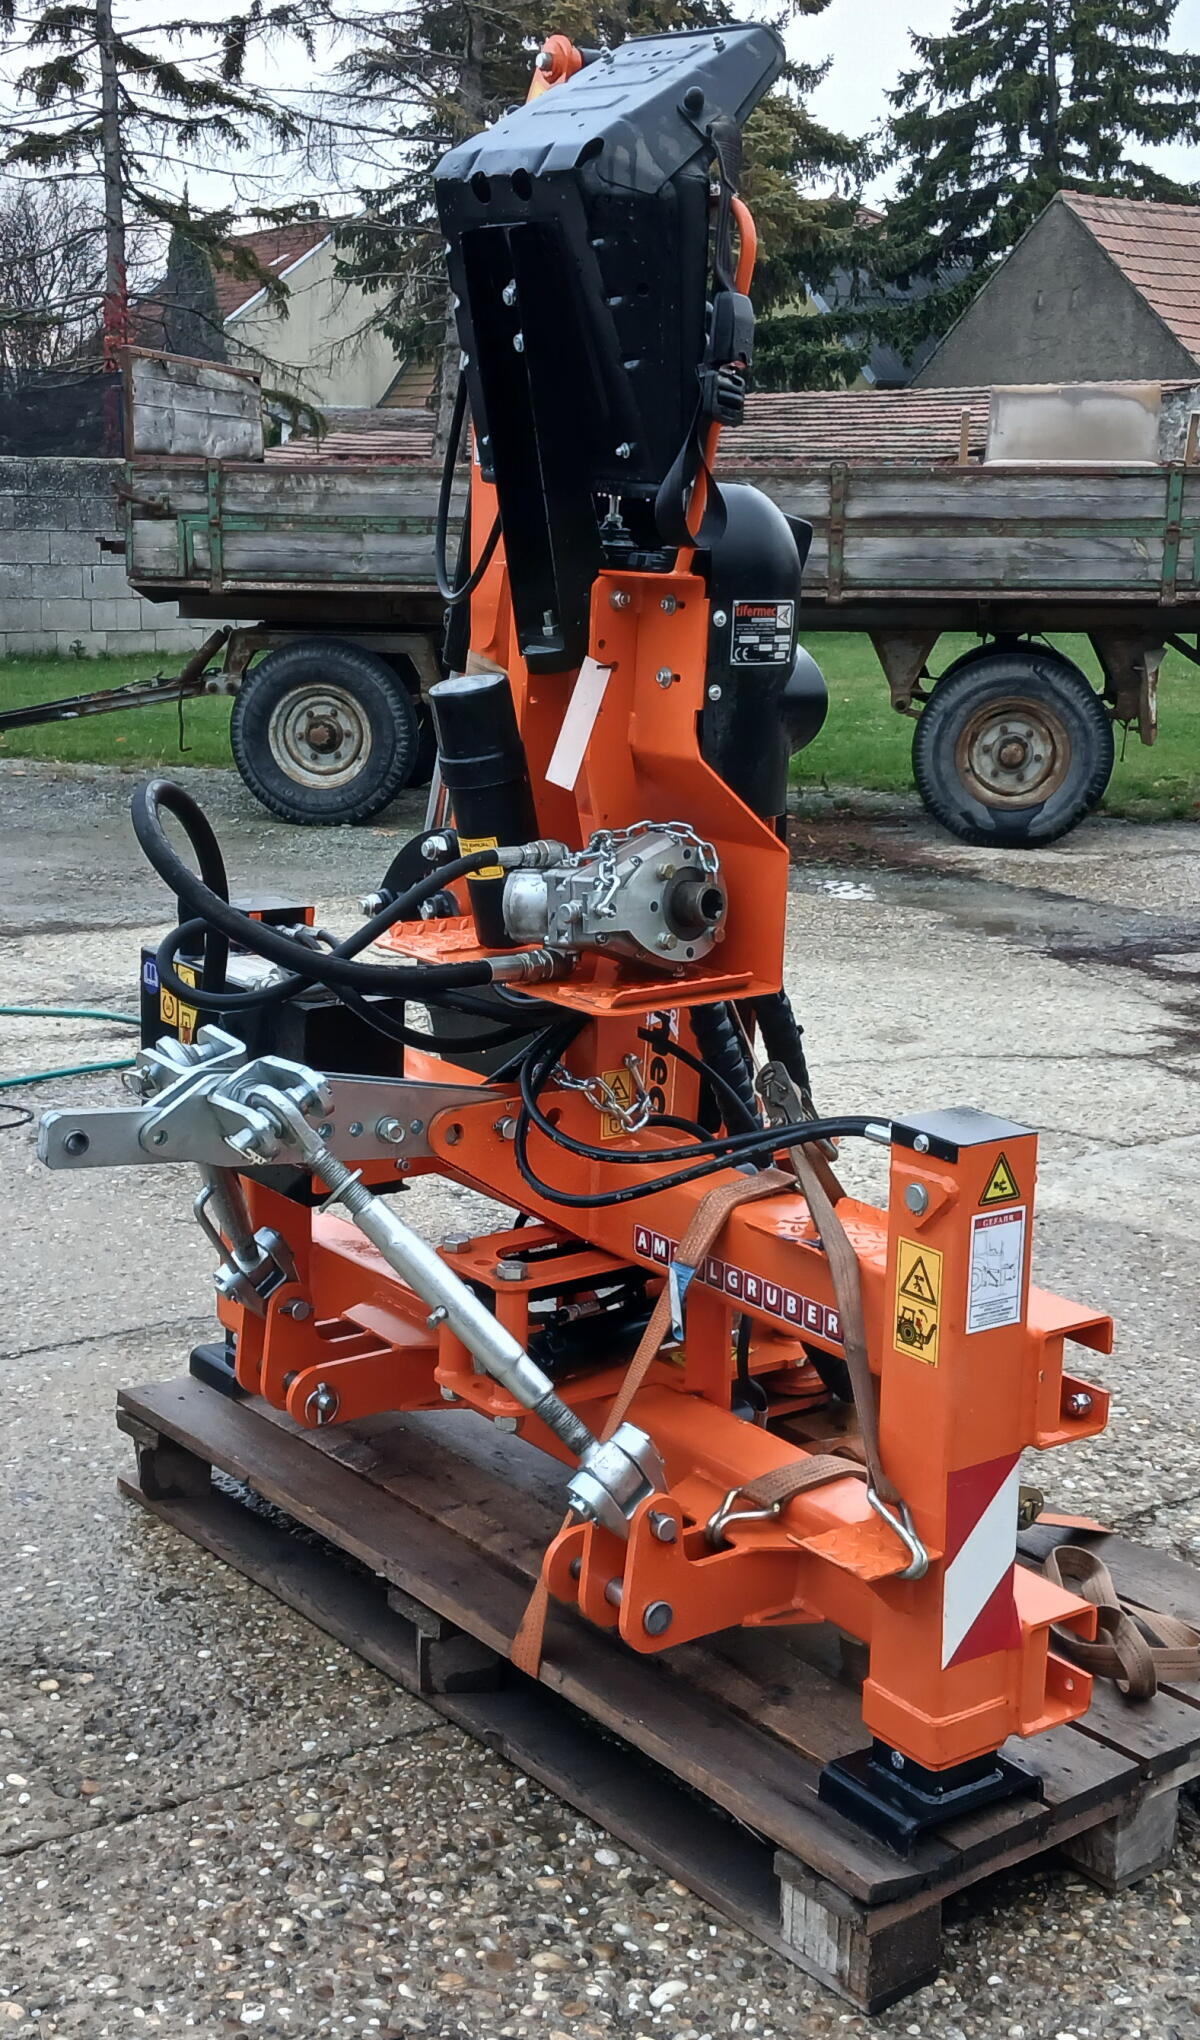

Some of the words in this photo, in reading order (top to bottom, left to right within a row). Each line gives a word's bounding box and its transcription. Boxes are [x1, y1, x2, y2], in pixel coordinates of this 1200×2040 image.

[736, 605, 776, 617] tifermec
[982, 1214, 1015, 1227] GEFAHR
[635, 1231, 839, 1334] AMLGRUBER
